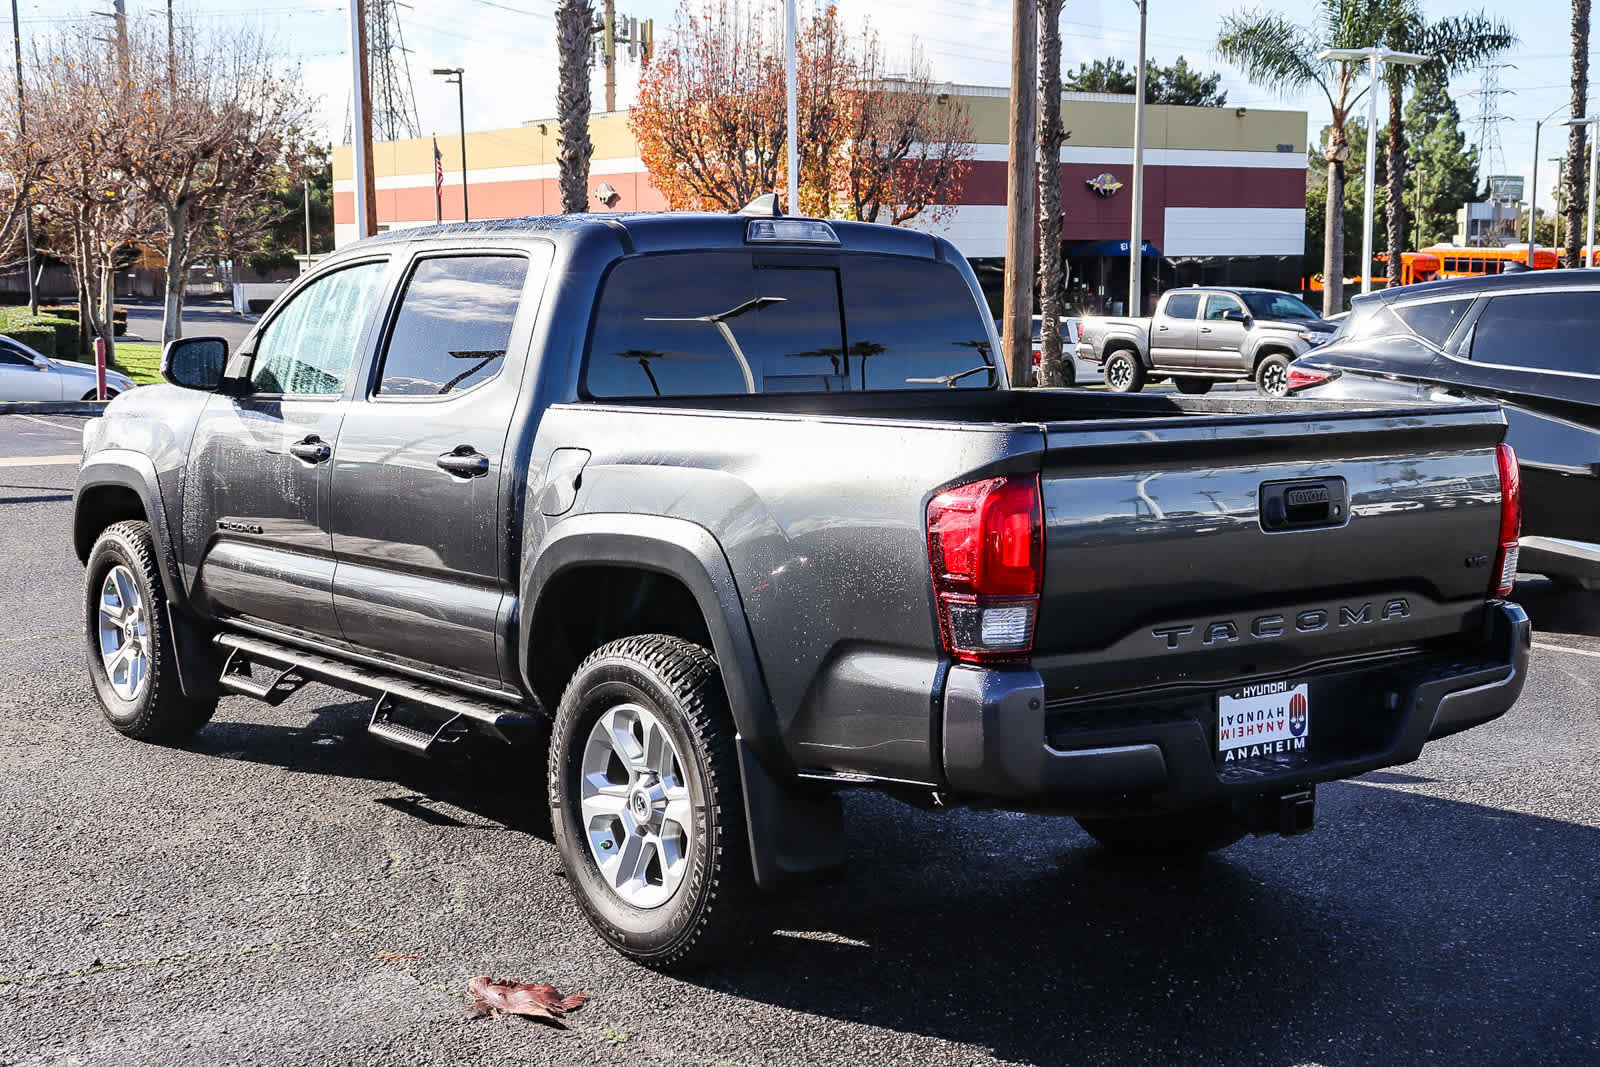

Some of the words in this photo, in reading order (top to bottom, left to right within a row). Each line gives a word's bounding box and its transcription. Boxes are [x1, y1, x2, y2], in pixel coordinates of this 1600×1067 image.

[1290, 489, 1329, 505] TOYOTA
[1152, 598, 1411, 650] TACOMA
[1243, 681, 1287, 698] HYUNDAI
[1220, 706, 1284, 727] HYUNDAI
[1220, 719, 1285, 741] ANAHEIM
[1225, 737, 1305, 762] ANAHEIM
